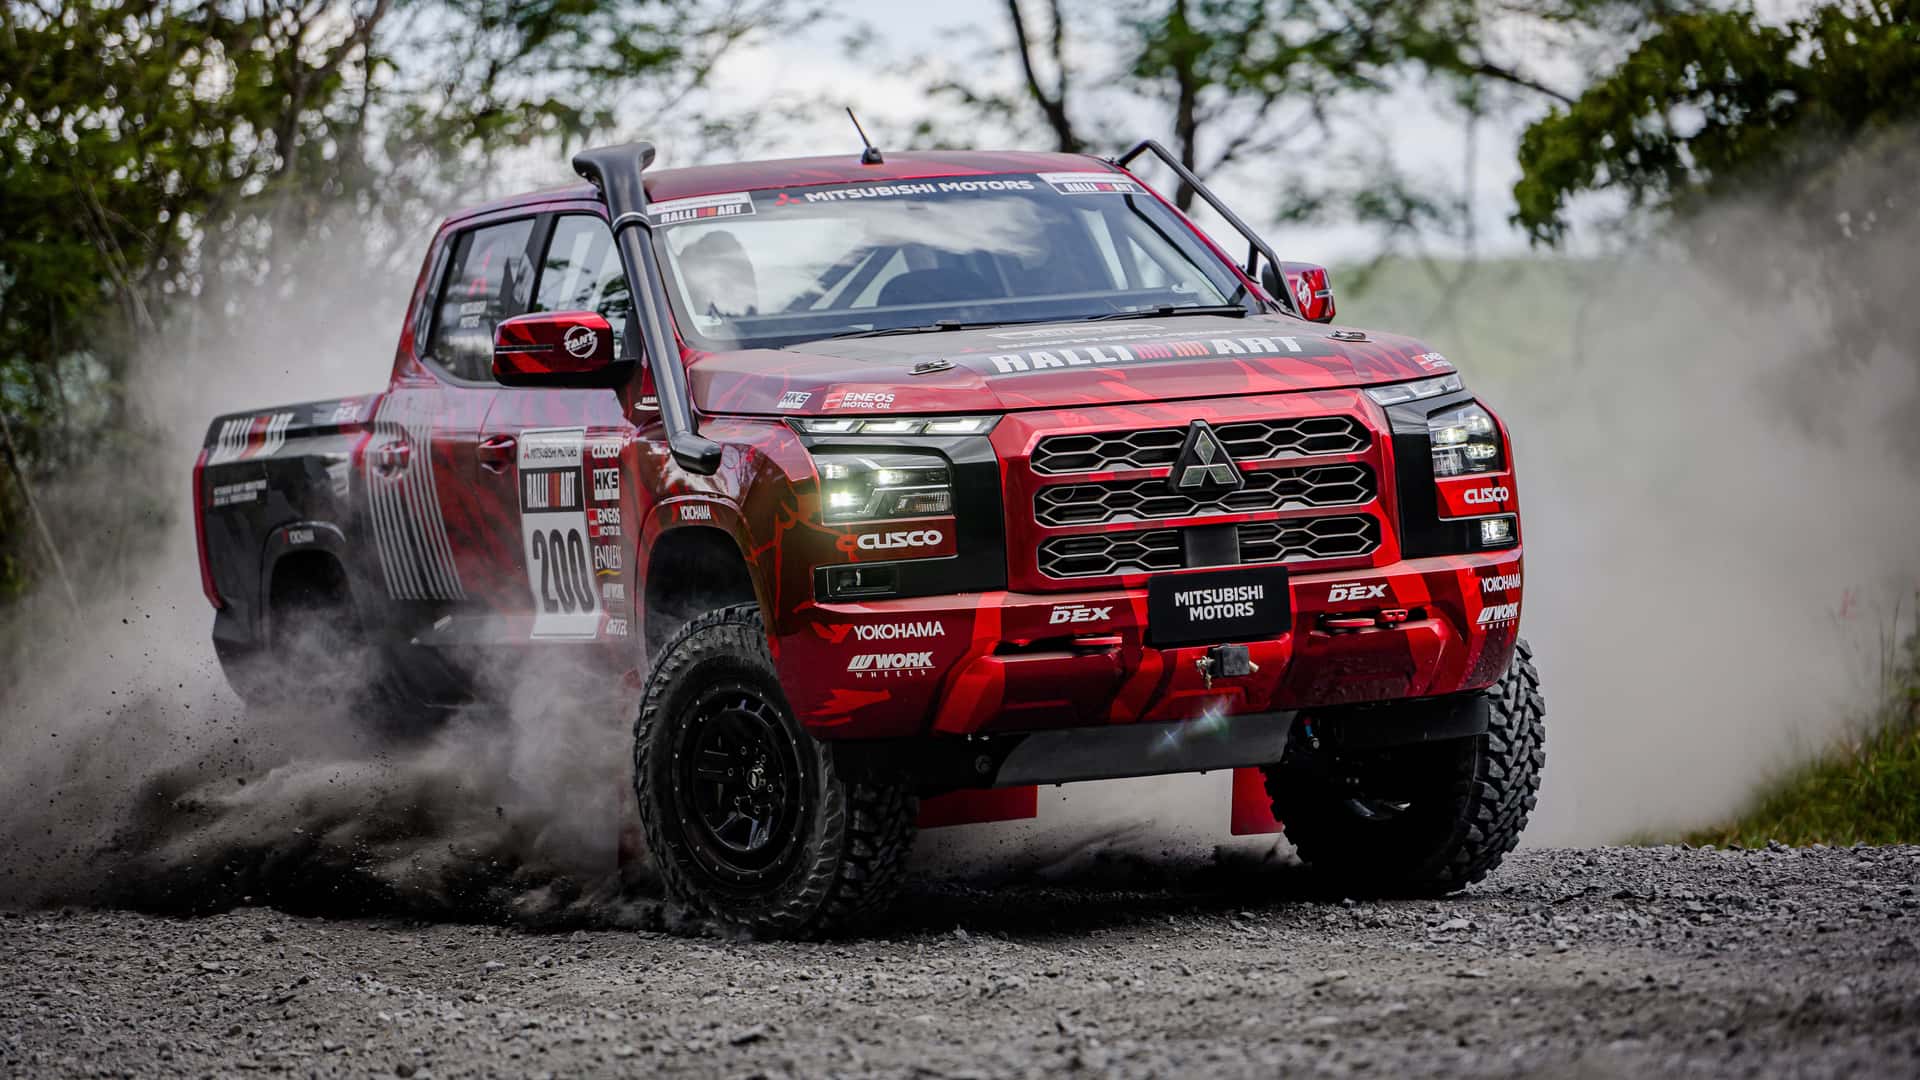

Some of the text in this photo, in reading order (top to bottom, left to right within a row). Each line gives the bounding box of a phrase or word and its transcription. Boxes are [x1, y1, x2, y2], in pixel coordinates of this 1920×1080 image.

[805, 180, 1035, 203] MITSUBISHI MOTORS
[783, 392, 809, 403] HKS
[840, 401, 874, 409] MOTOR
[843, 392, 896, 403] ENEOS
[591, 443, 620, 459] CUSCO
[594, 470, 619, 490] HKS
[1464, 486, 1509, 504] CUSCO
[680, 504, 712, 520] YOKOHAMA
[857, 529, 943, 550] CUSCO
[532, 527, 595, 614] 200
[1482, 573, 1521, 592] YOKOHAMA
[1175, 585, 1264, 607] MITSUBISHI
[1328, 584, 1388, 602] DEX
[1049, 606, 1114, 625] DEX
[1189, 602, 1255, 621] MOTORS
[853, 620, 945, 641] YOKOHAMA
[873, 651, 934, 670] WORK
[855, 669, 926, 679] WHEELS
